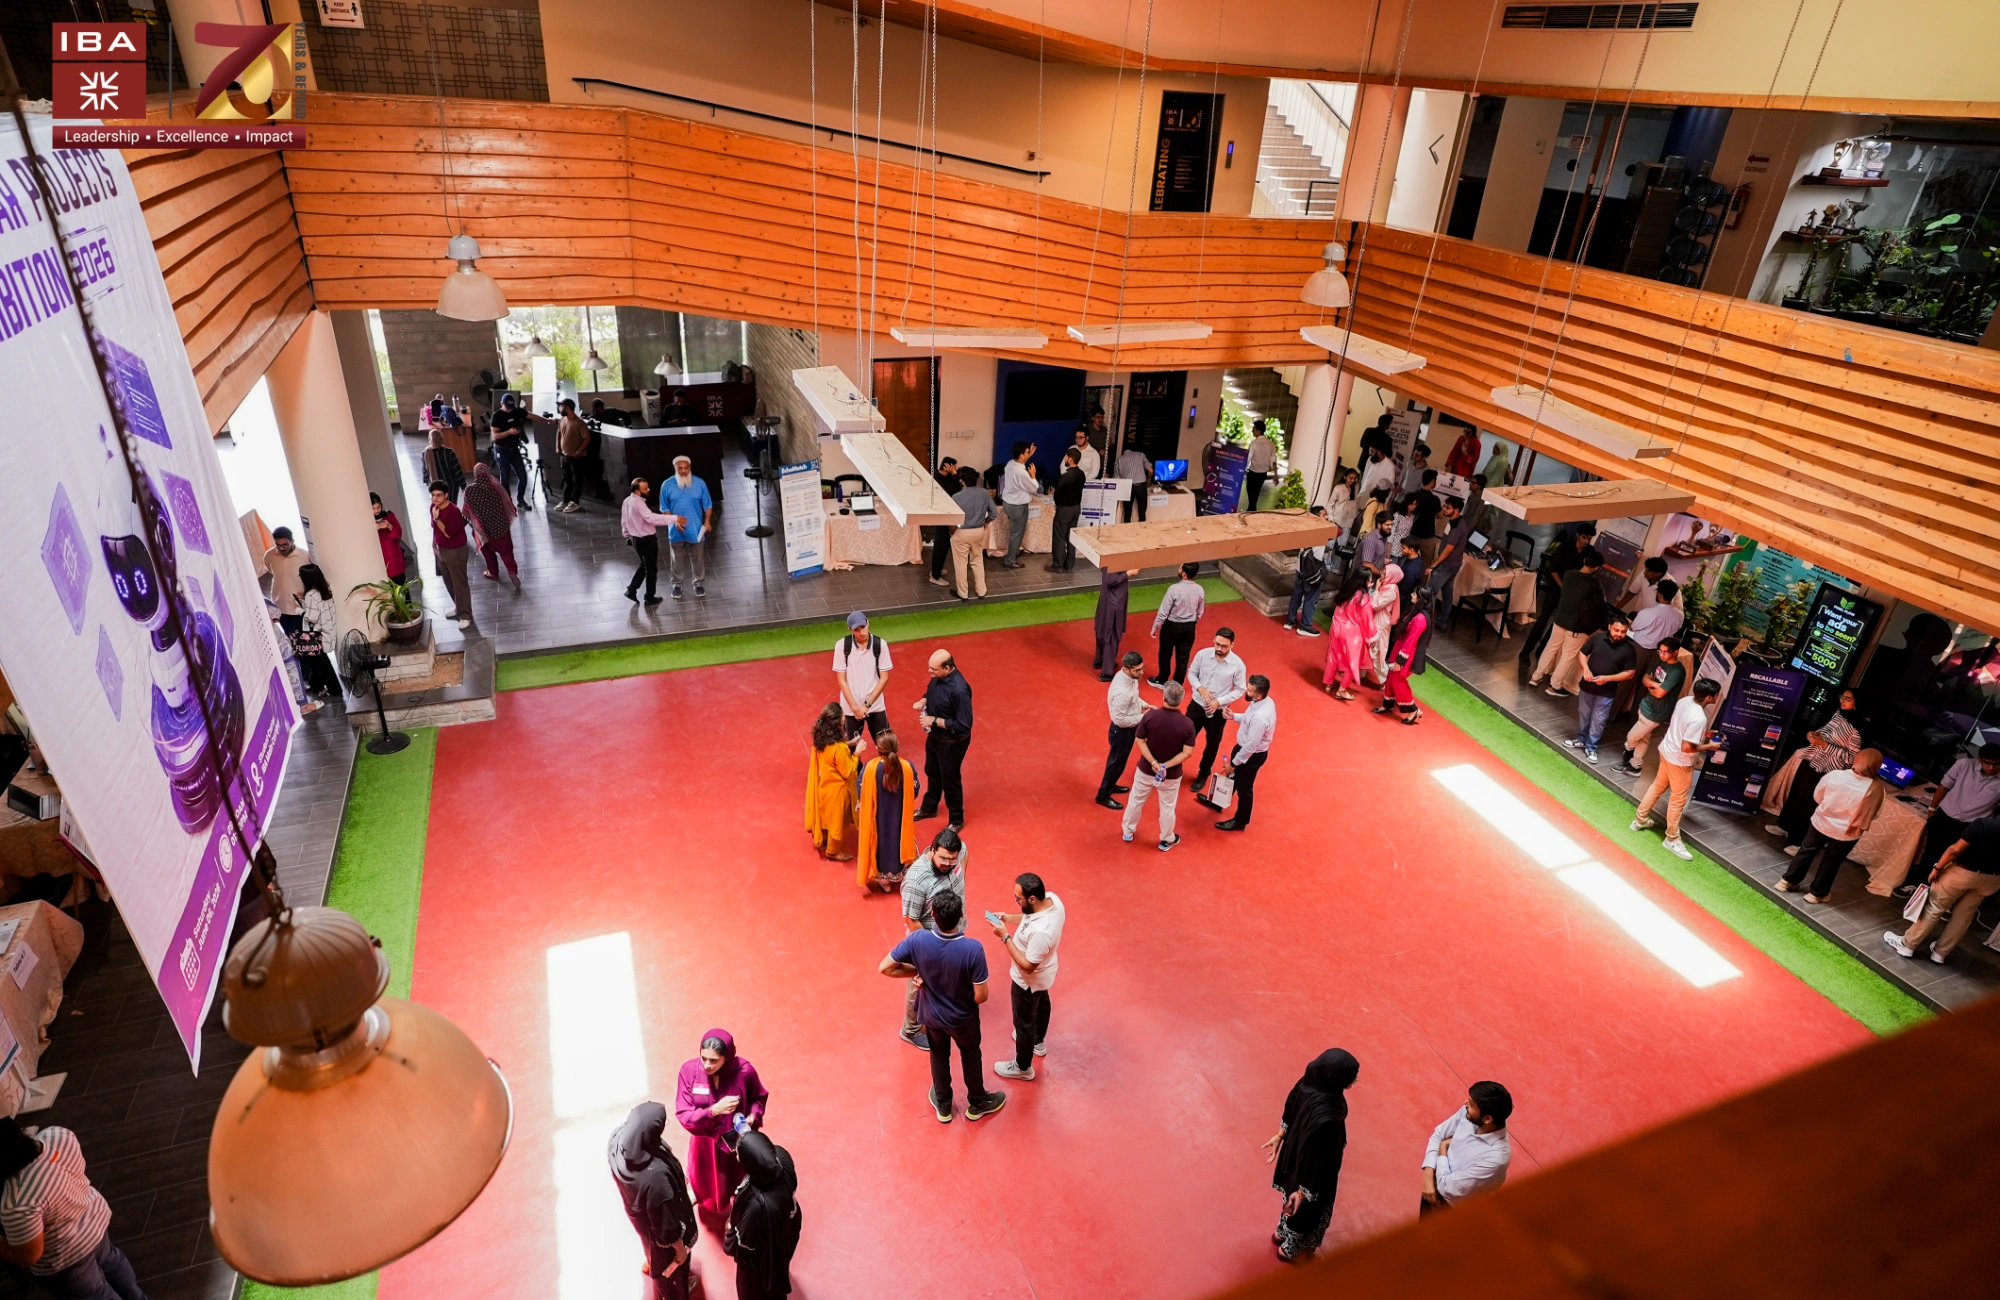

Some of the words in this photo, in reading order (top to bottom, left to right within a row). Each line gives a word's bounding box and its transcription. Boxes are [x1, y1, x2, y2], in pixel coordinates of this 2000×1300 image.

[1154, 138, 1171, 210] LEBRATING
[69, 237, 116, 290] 2026
[1824, 608, 1842, 620] Want
[1842, 616, 1858, 628] your
[1828, 619, 1847, 632] ads
[1825, 625, 1834, 633] be
[1835, 630, 1856, 642] seen?
[1812, 652, 1836, 669] 5000
[1750, 673, 1788, 686] RECALLABLE
[193, 890, 210, 938] Saturday
[198, 923, 208, 950] June
